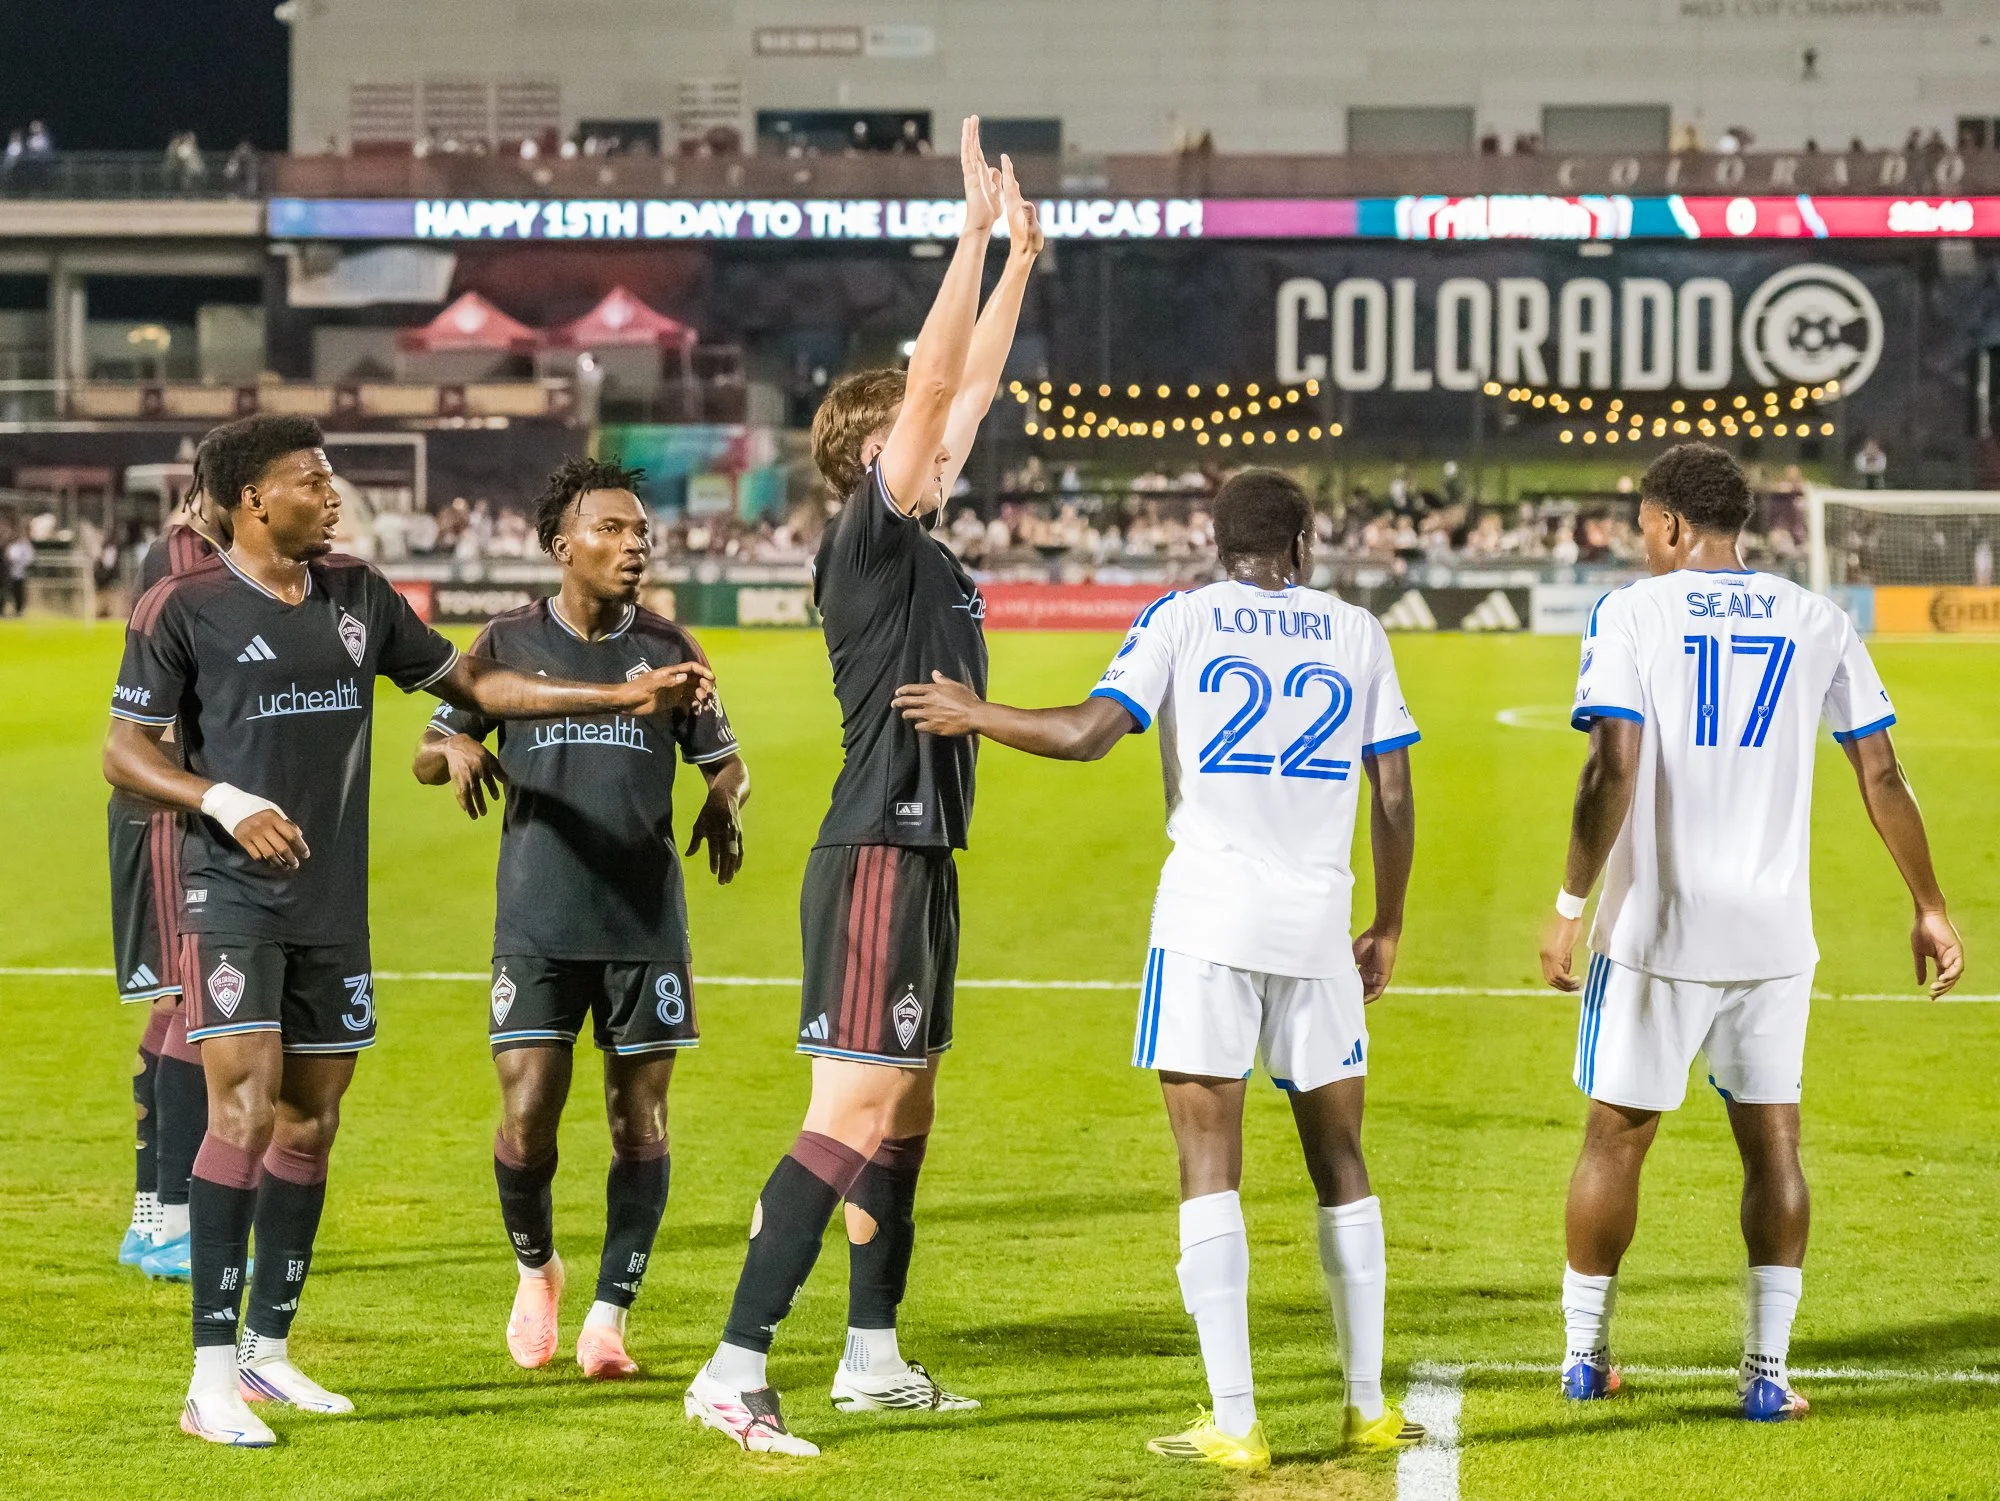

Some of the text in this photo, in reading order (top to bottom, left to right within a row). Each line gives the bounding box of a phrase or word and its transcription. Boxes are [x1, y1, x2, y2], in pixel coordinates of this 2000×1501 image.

[414, 200, 541, 238] HAPPY
[542, 200, 638, 238] 15TH
[643, 200, 743, 238] BDAY
[746, 200, 803, 238] TO
[805, 200, 882, 238] THE
[1041, 200, 1162, 238] LUCAS
[1276, 277, 1735, 391] COLORADO
[1213, 607, 1333, 641] LOTURI
[1686, 592, 1777, 619] SEALY
[258, 677, 359, 716] uchealth
[1684, 635, 1796, 748] 17
[535, 715, 645, 750] uchealth
[1199, 655, 1353, 781] 22
[341, 973, 375, 1031] 3
[655, 972, 685, 1026] 8
